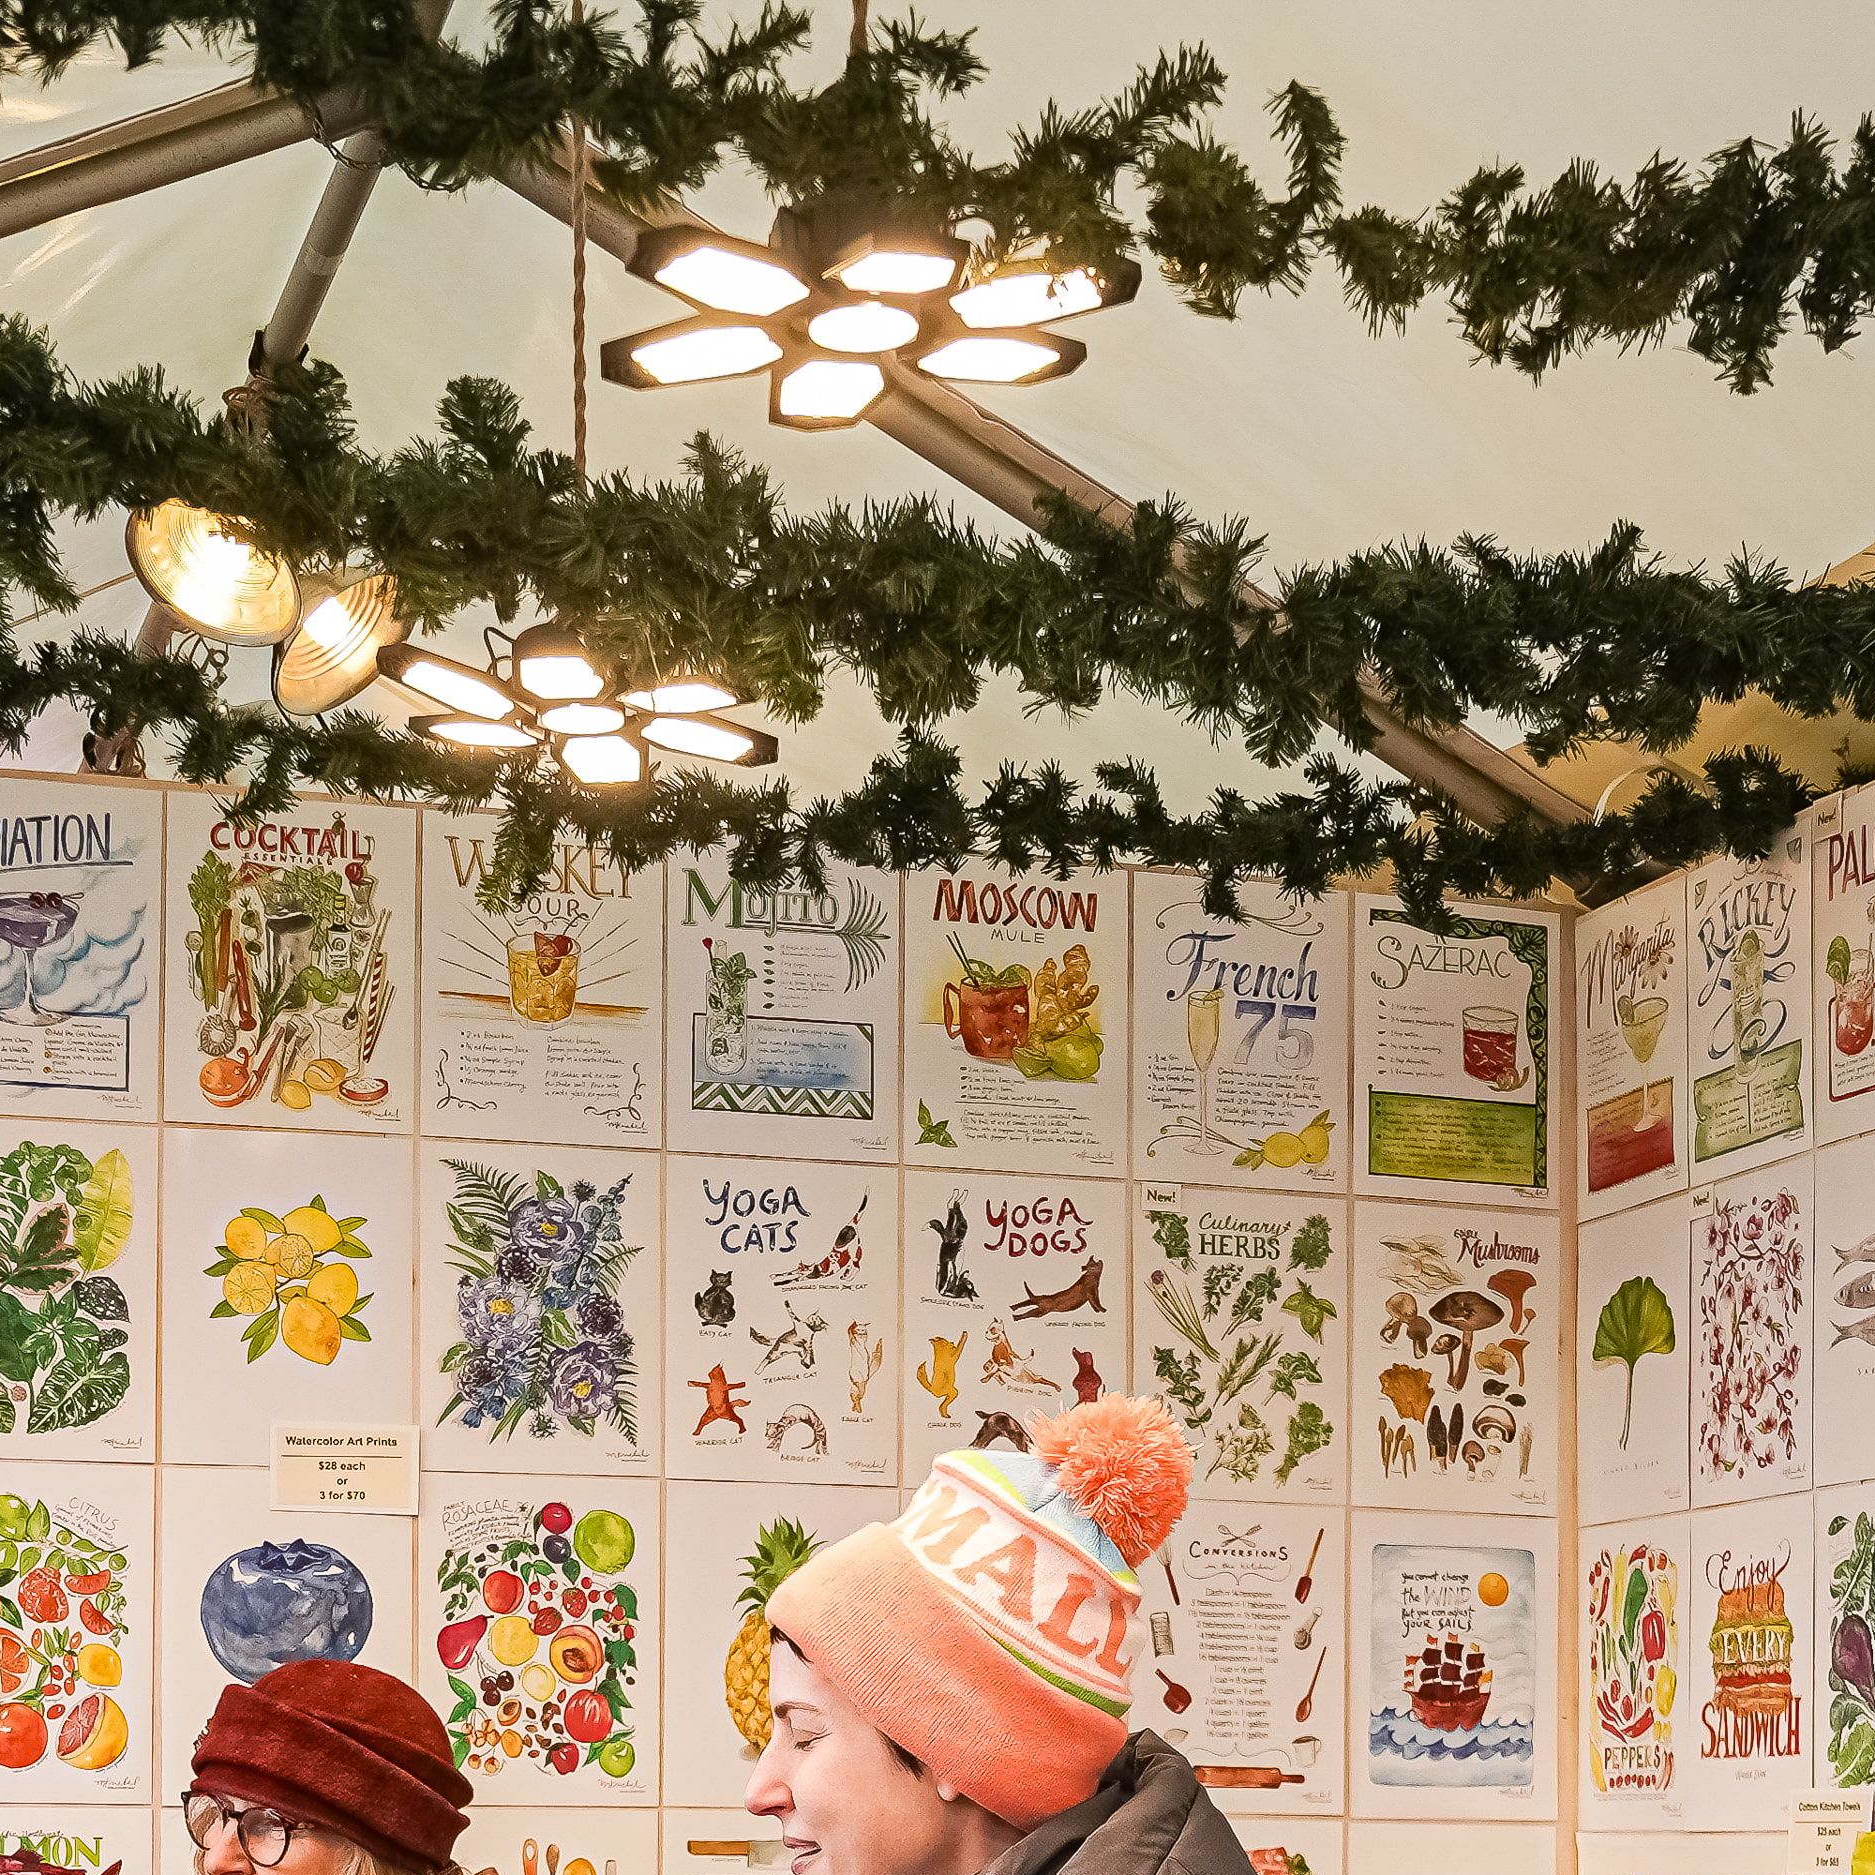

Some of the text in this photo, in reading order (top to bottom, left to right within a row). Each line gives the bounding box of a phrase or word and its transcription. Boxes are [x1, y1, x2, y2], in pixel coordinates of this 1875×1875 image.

[210, 821, 367, 862] COCKTAIL
[445, 835, 632, 899] WSKEY
[933, 881, 1097, 933] MOSCOW
[1698, 878, 1798, 966] RICKEY
[991, 928, 1045, 944] MULE
[1165, 929, 1320, 1003] French
[1370, 934, 1513, 990] SAZERAC
[1233, 1000, 1317, 1071] 75
[703, 1178, 811, 1226] YOGA
[1147, 1188, 1176, 1204] New!
[720, 1221, 797, 1254] CATS
[983, 1196, 1093, 1250] YOGA
[1198, 1212, 1292, 1236] Culinary
[1007, 1228, 1088, 1257] DOGS
[1199, 1233, 1281, 1261] HERBS
[1457, 1232, 1540, 1267] Mushrooms
[286, 1436, 397, 1446] Watercolor Art Prints
[319, 1461, 365, 1470] $28 each
[320, 1491, 365, 1500] 3 for $70
[69, 1497, 120, 1530] CITRUS
[1189, 1541, 1288, 1561] CONVERSIONS
[1705, 1538, 1792, 1596] Enjoy
[901, 1479, 1132, 1679] MALL
[1723, 1630, 1790, 1664] EVERY
[1700, 1696, 1800, 1760] SANDWICH
[1604, 1744, 1661, 1772] PEPPERS
